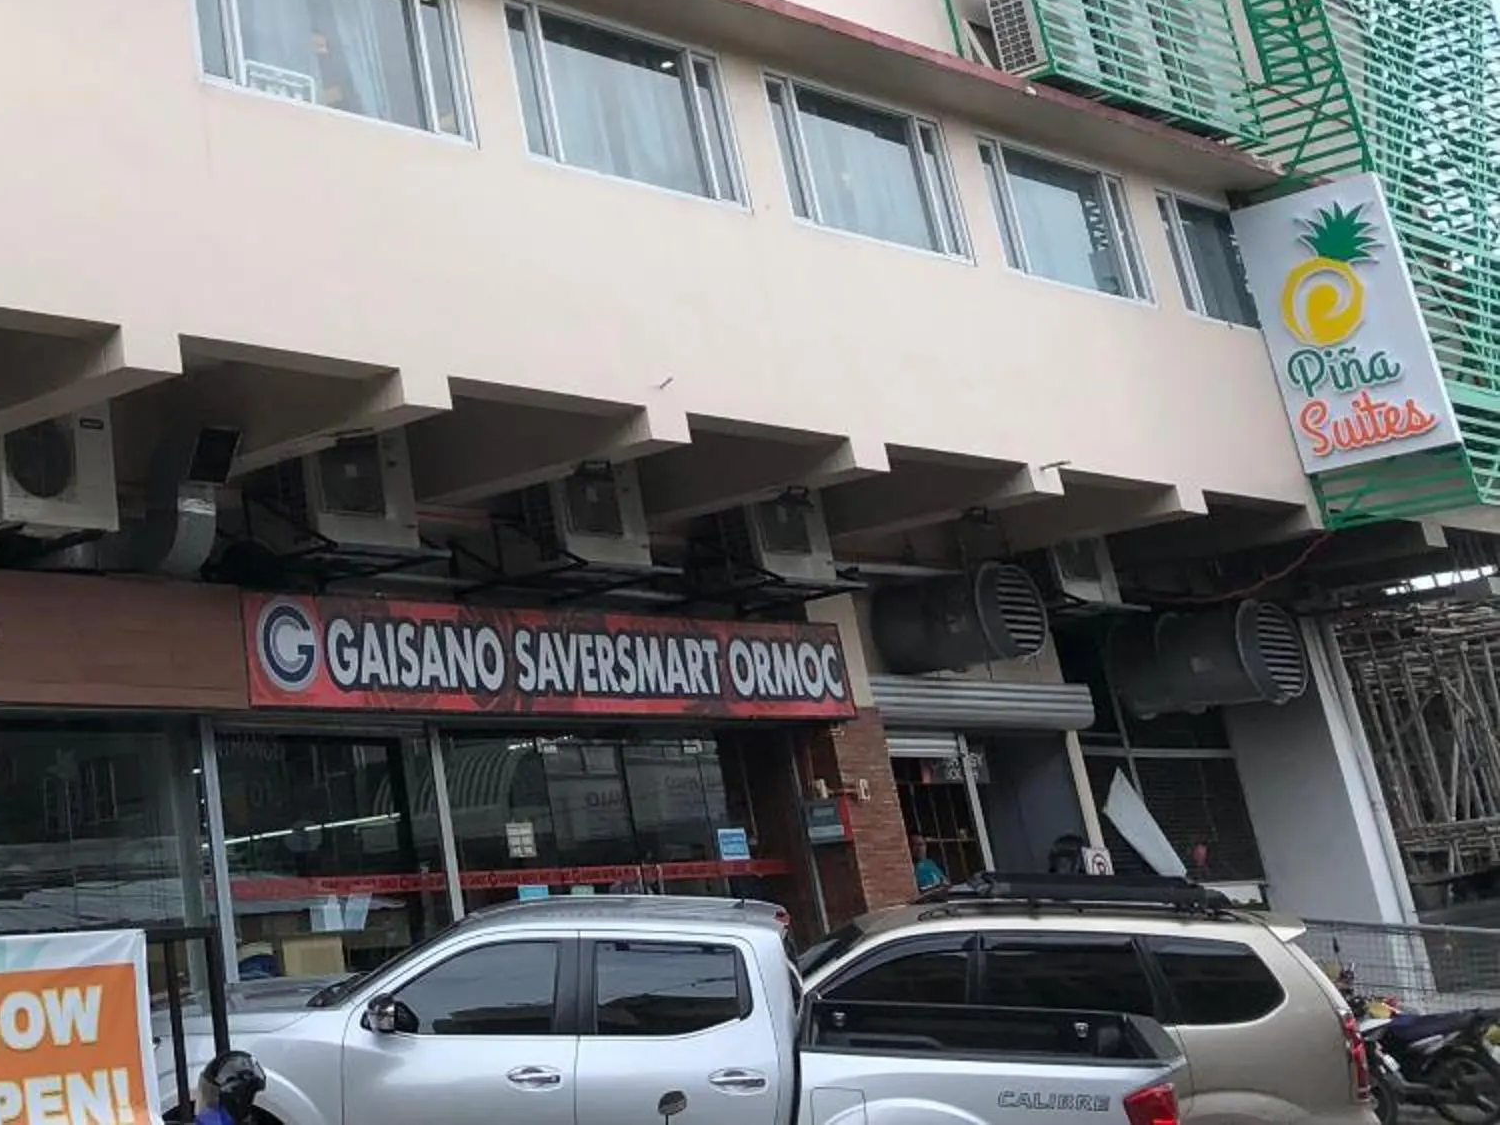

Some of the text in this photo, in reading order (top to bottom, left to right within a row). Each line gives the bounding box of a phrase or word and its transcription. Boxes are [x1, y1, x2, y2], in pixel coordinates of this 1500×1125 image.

[1287, 346, 1403, 397] Piña
[1299, 391, 1437, 457] Suites
[326, 617, 506, 692] GAISANO
[515, 628, 721, 697] SAVERSMART
[728, 640, 845, 701] ORMOC
[998, 1090, 1111, 1112] CALIBRE
